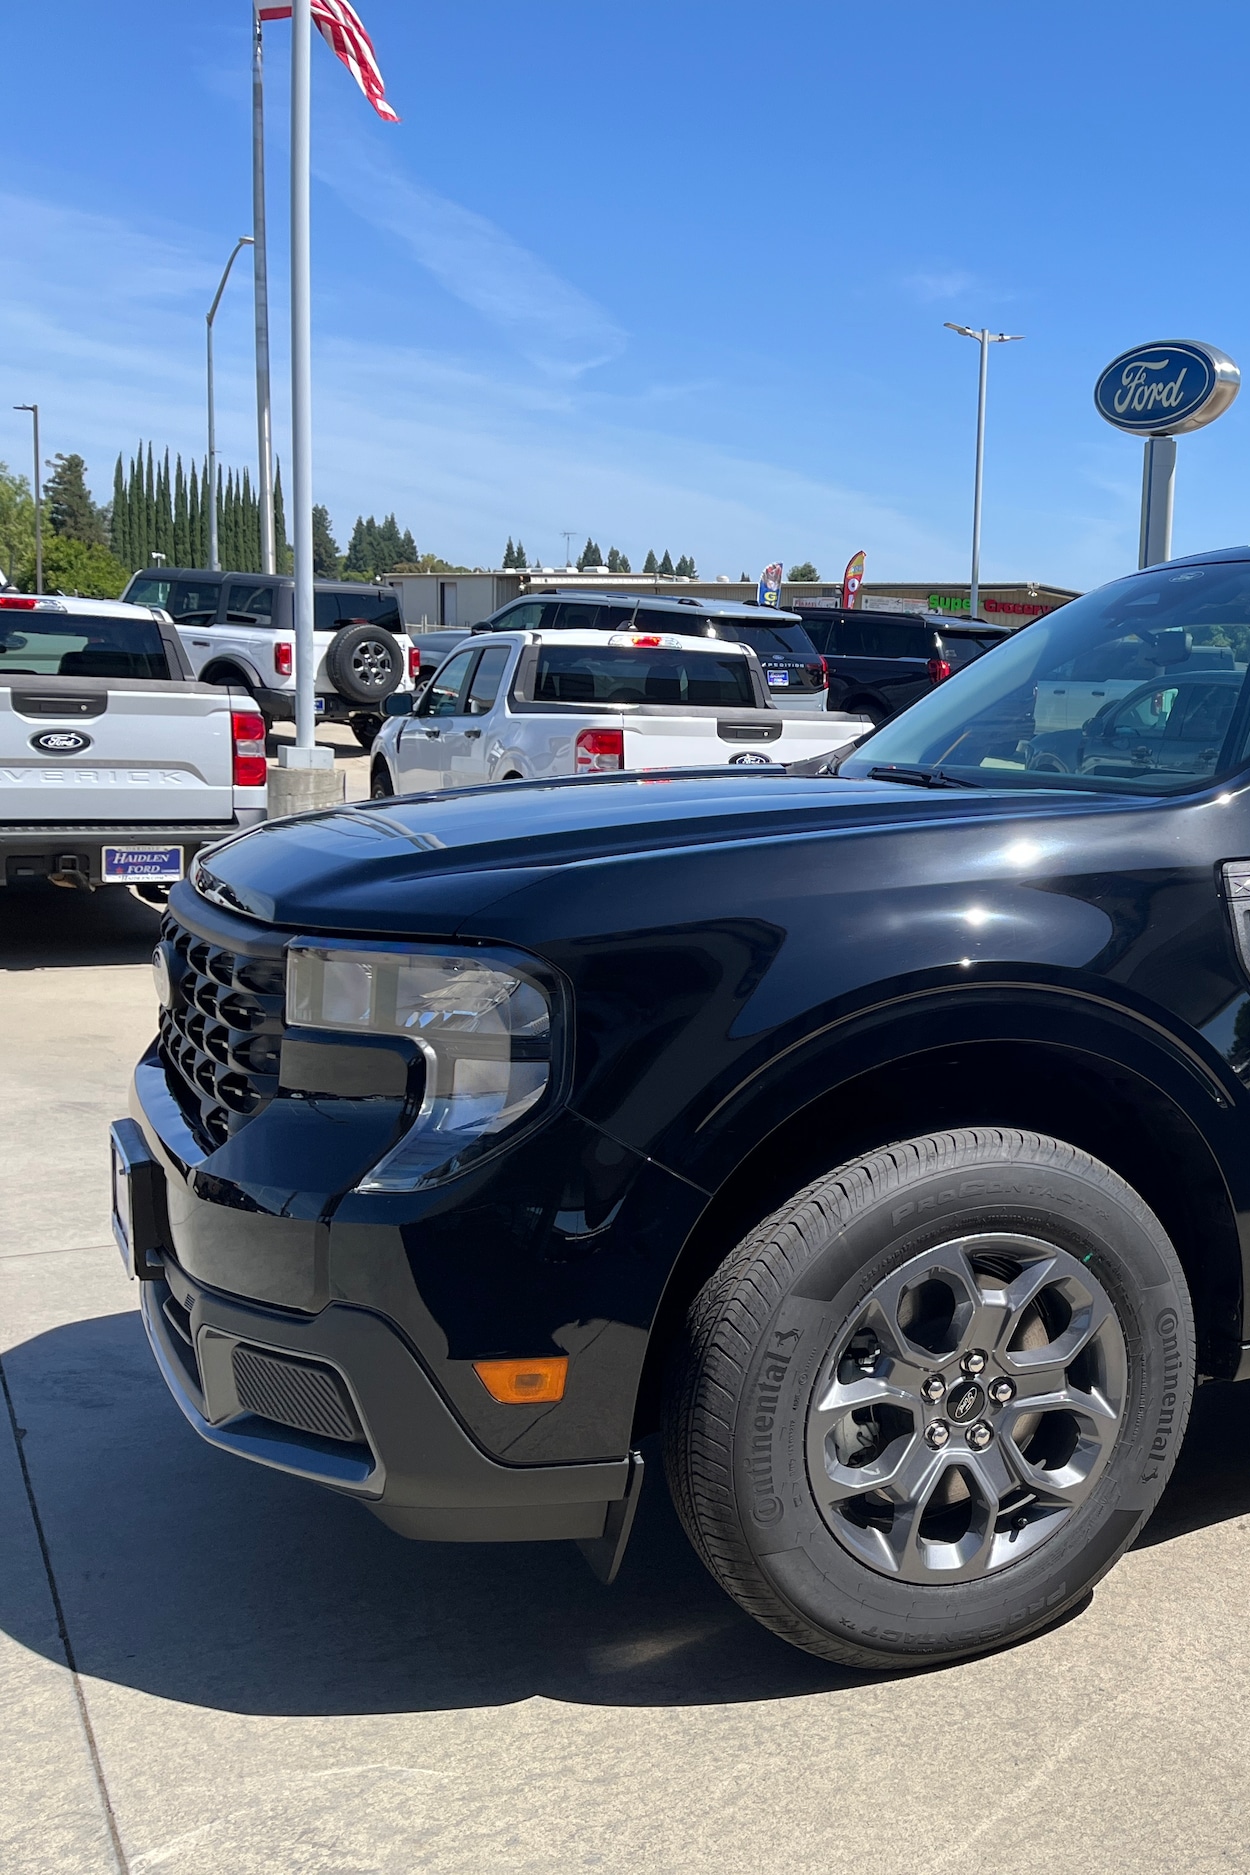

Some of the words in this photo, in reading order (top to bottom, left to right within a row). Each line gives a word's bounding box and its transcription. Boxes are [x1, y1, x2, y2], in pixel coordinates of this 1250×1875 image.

[1114, 359, 1187, 413] Ford
[928, 594, 982, 612] Supe
[48, 736, 75, 747] Ford
[0, 769, 183, 785] VERICK
[113, 852, 169, 864] HAIDLEN
[127, 865, 160, 874] FORD
[1149, 1307, 1183, 1462] Continental
[744, 1350, 793, 1529] Continental
